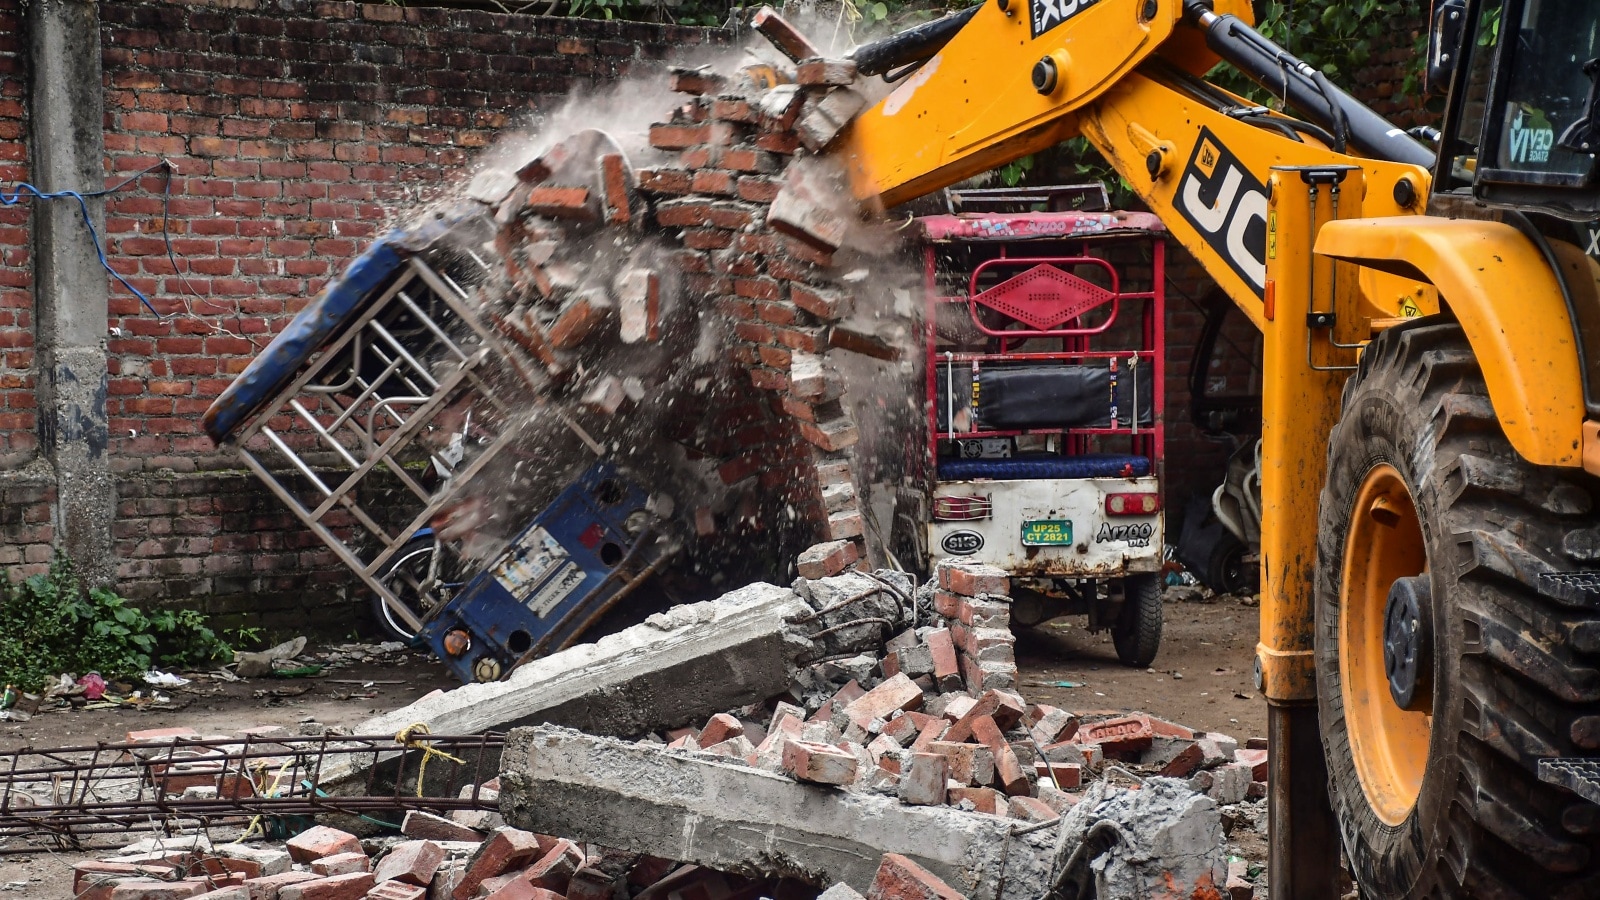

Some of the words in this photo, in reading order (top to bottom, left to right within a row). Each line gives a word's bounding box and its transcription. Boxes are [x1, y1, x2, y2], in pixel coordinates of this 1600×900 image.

[1032, 524, 1061, 532] UP25
[1027, 533, 1042, 541] CT
[1044, 533, 1068, 541] 2821
